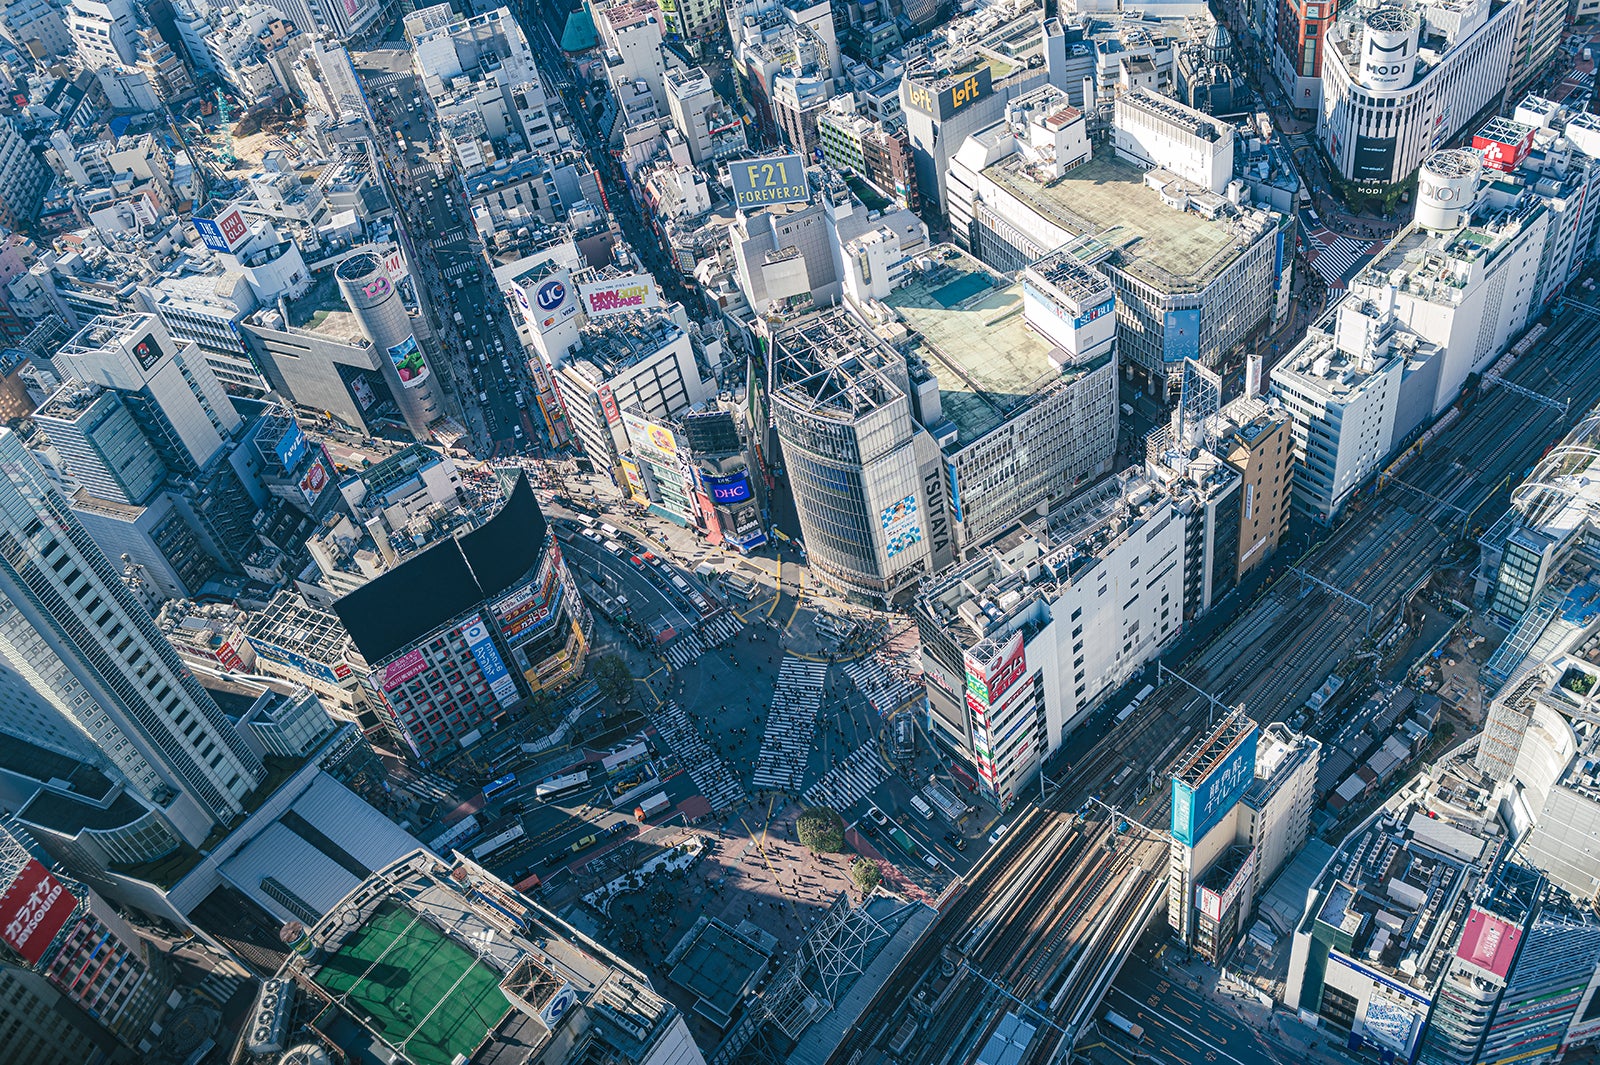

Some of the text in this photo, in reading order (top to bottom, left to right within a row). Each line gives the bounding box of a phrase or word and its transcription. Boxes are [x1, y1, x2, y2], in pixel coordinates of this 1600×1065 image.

[1366, 62, 1406, 76] MODI
[747, 162, 788, 188] F21
[738, 185, 805, 203] FOREVER 21
[1357, 187, 1383, 195] MODI
[223, 215, 239, 231] UNI
[228, 223, 244, 240] QLO
[362, 276, 391, 299] 109
[538, 284, 565, 307] UC
[562, 306, 576, 317] VISA
[714, 486, 745, 498] DHC
[923, 466, 950, 553] TSUTAYA
[990, 656, 1023, 692] アコム
[5, 876, 50, 941] カラオケ
[16, 885, 63, 949] JOYSOUND
